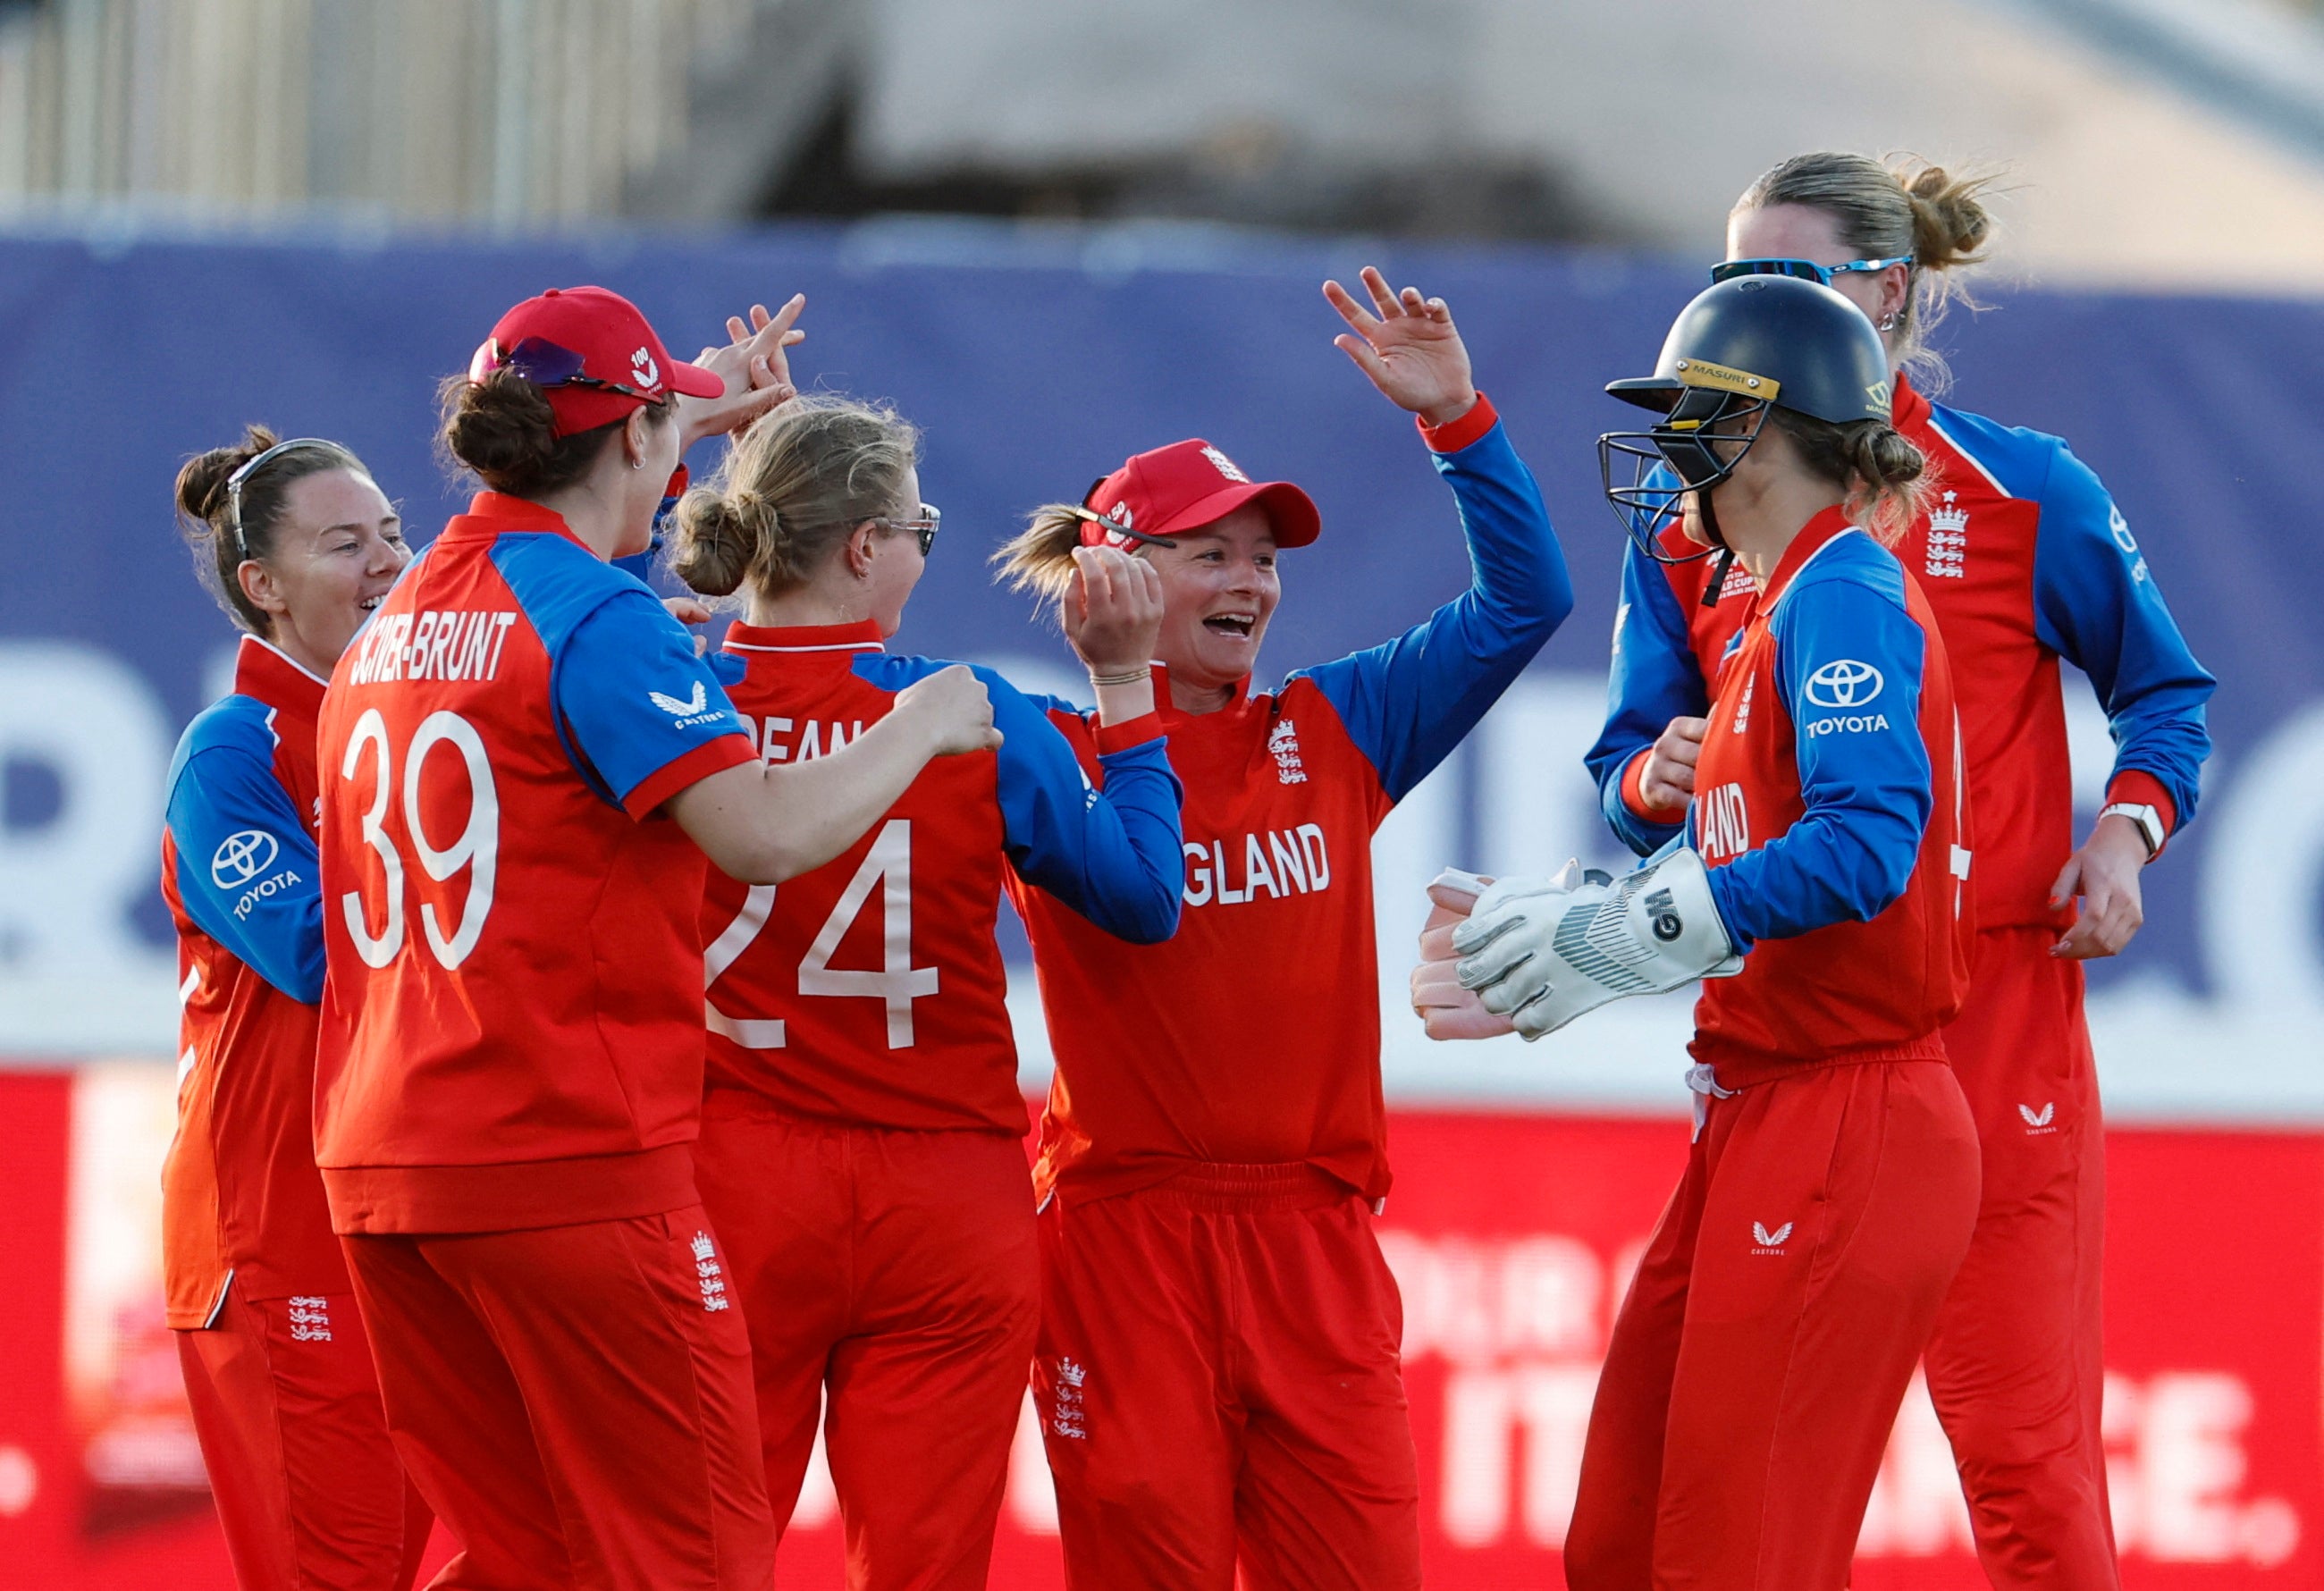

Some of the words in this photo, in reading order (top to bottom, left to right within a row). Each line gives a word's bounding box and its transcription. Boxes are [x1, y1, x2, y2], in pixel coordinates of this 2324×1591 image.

[631, 346, 649, 368] 100
[1693, 365, 1746, 384] MASURI
[1734, 577, 1755, 587] CUP
[1806, 713, 1890, 739] TOYOTA
[341, 708, 500, 972] 39
[1696, 782, 1749, 861] LAND
[1182, 822, 1330, 907] GLAND
[233, 870, 302, 922] TOYOTA
